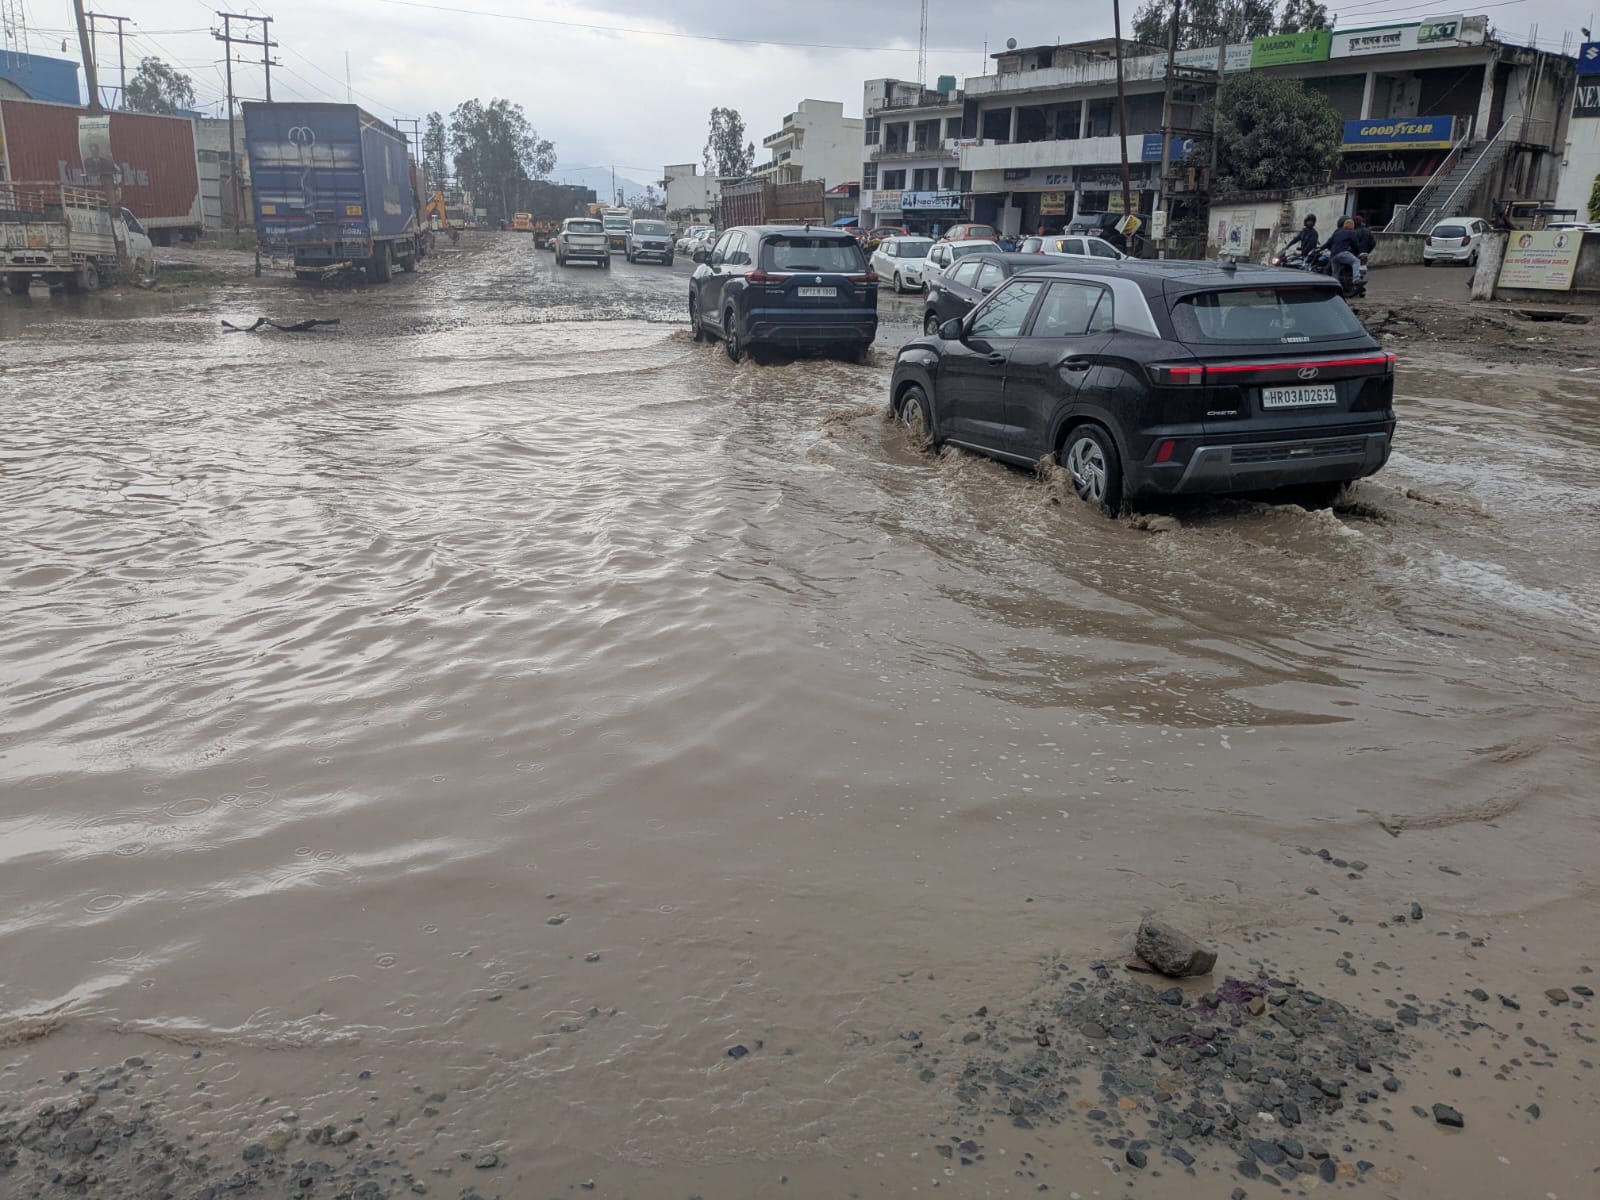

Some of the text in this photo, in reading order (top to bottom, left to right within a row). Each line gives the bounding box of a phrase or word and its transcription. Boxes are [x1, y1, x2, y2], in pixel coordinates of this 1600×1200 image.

[1418, 21, 1457, 40] BKT
[1258, 39, 1296, 51] AMARON
[1360, 121, 1433, 137] GOODYEAR
[1344, 159, 1406, 174] YOKOHAMA
[1270, 389, 1335, 404] HR03AD2632
